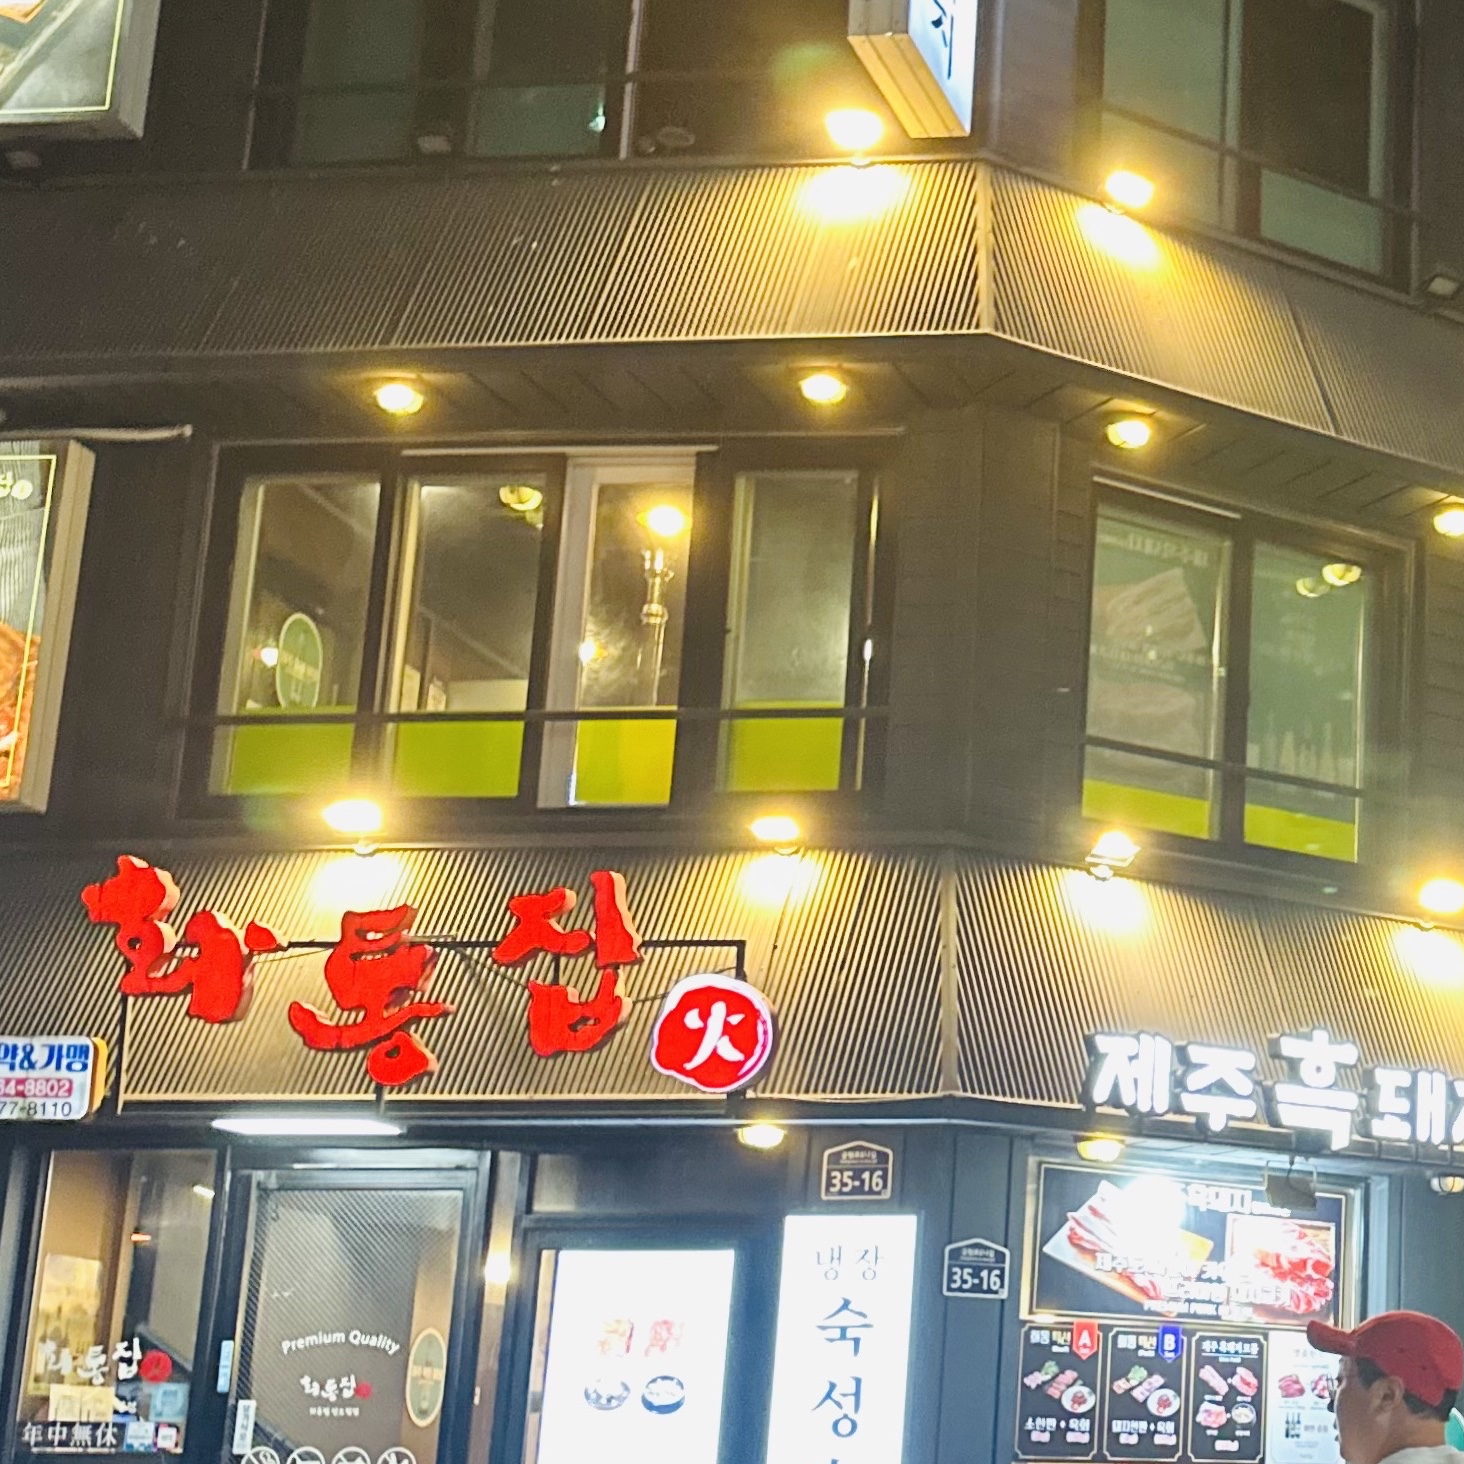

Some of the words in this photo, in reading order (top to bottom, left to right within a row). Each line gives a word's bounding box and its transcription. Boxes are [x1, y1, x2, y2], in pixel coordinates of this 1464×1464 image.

[81, 854, 644, 1087] 화통집
[684, 1001, 746, 1071] 火
[829, 1170, 883, 1193] 35-16
[816, 1245, 885, 1281] 냉장
[950, 1268, 1001, 1291] 35-16
[281, 1331, 345, 1354] Premium
[350, 1330, 399, 1355] Quality
[1078, 1330, 1091, 1346] A
[1164, 1334, 1175, 1350] B
[39, 1337, 142, 1385] 화통집
[22, 1423, 118, 1446] 年中無休
